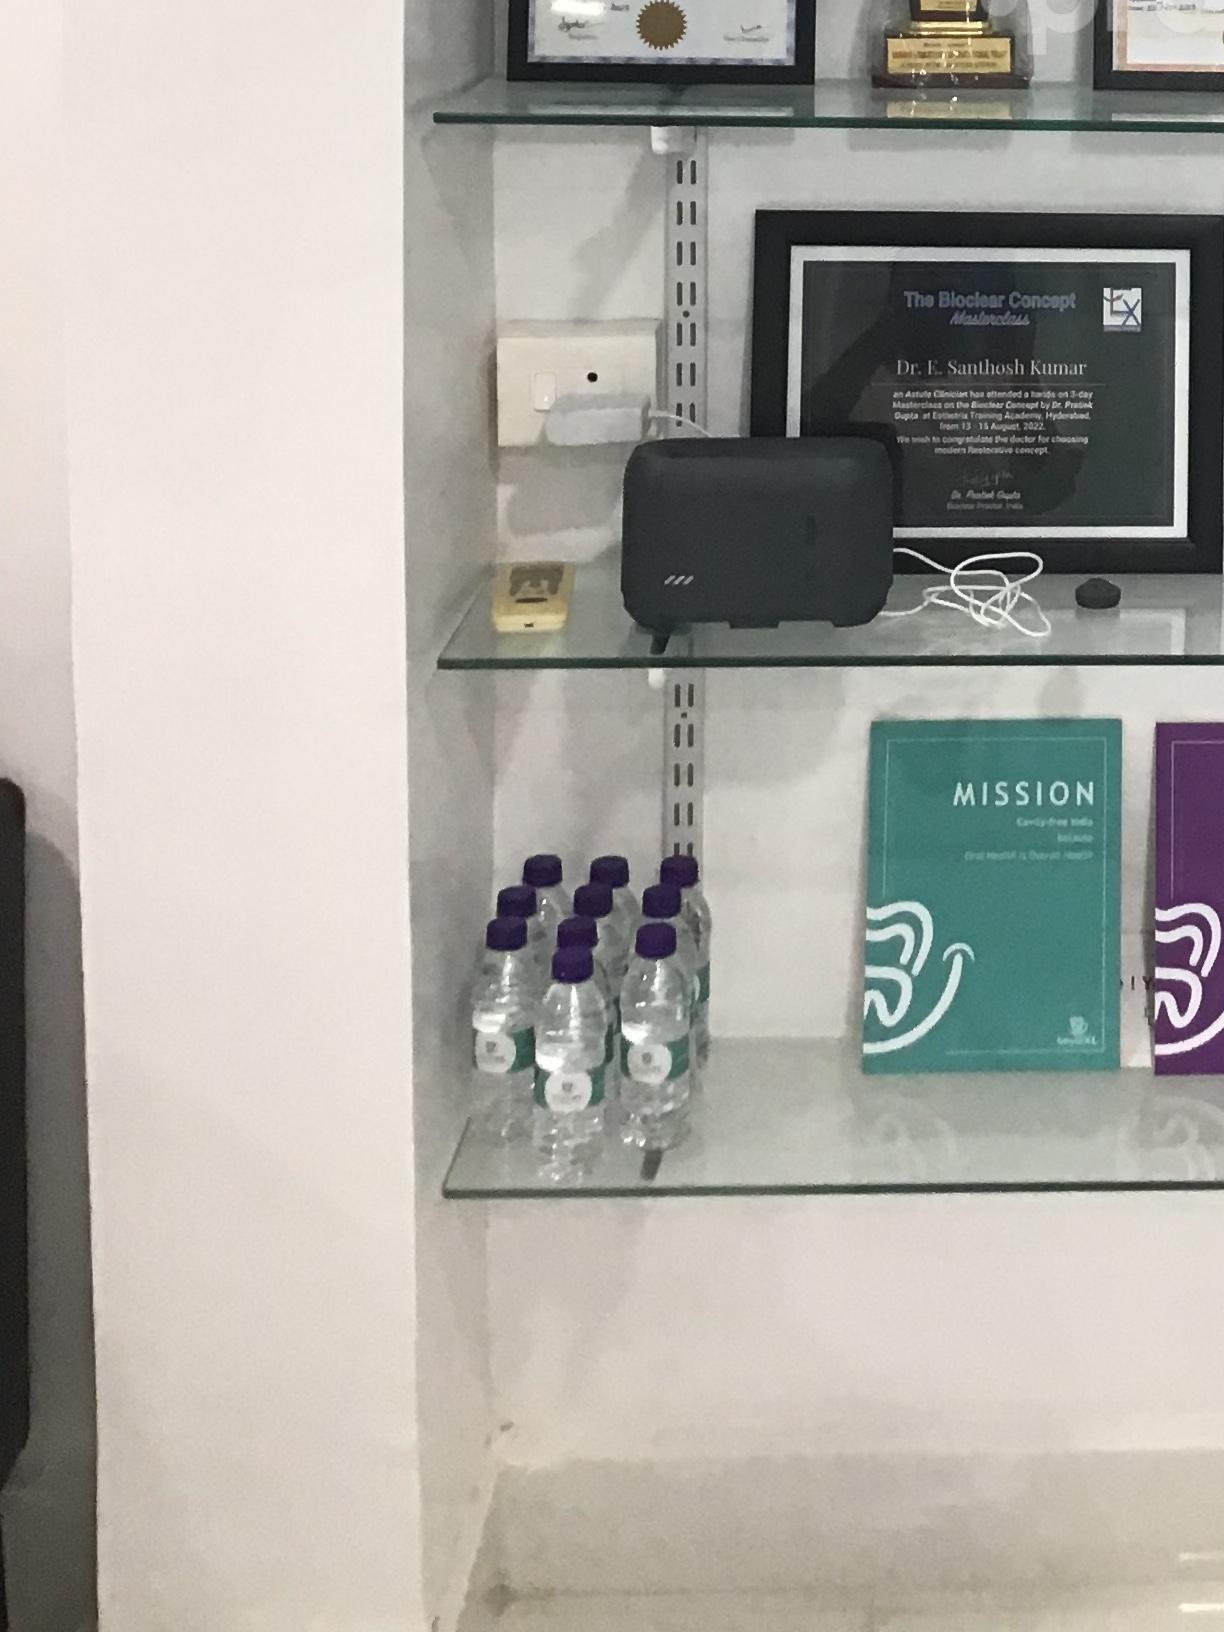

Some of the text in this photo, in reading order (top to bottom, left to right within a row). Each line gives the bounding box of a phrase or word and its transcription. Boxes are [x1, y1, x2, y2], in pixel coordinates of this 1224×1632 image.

[904, 291, 1076, 312] The Bioclear Concept
[950, 310, 1031, 326] Masterclass
[897, 358, 1088, 376] Dr. E. Santhosh Kumar
[953, 781, 1094, 806] MISSION
